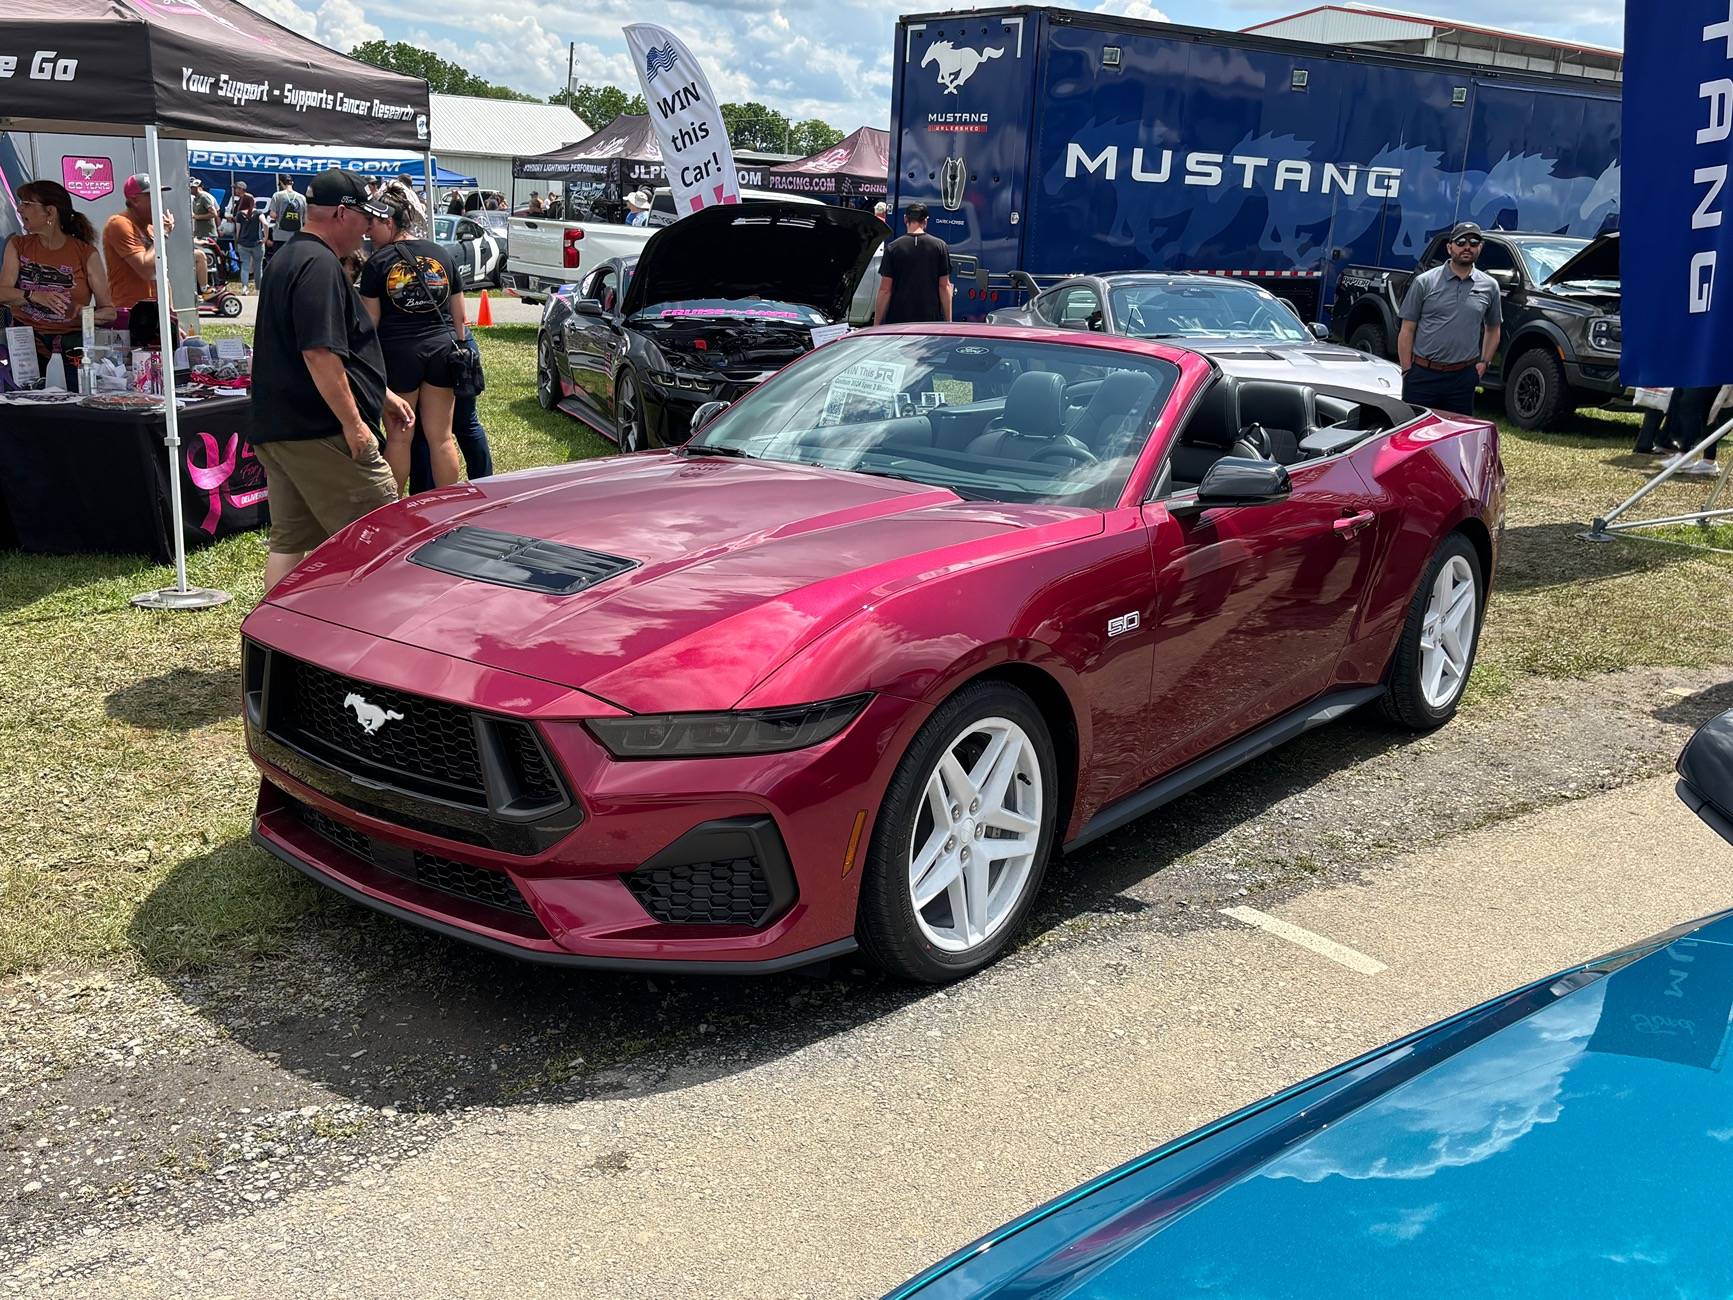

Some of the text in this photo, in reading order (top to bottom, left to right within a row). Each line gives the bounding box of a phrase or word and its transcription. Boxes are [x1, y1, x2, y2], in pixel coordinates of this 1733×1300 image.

[29, 50, 79, 81] Go
[182, 66, 216, 94] Your
[217, 73, 270, 106] Support
[283, 83, 334, 112] Supports
[335, 92, 371, 116] Cancer
[371, 98, 415, 120] Research
[656, 82, 701, 119] WIN
[928, 113, 989, 122] MUSTANG
[671, 121, 710, 153] this
[543, 164, 570, 173] LIGHTNING
[570, 164, 608, 175] PERFORMANCE
[680, 151, 722, 188] Car!
[1065, 142, 1404, 199] MUSTANG
